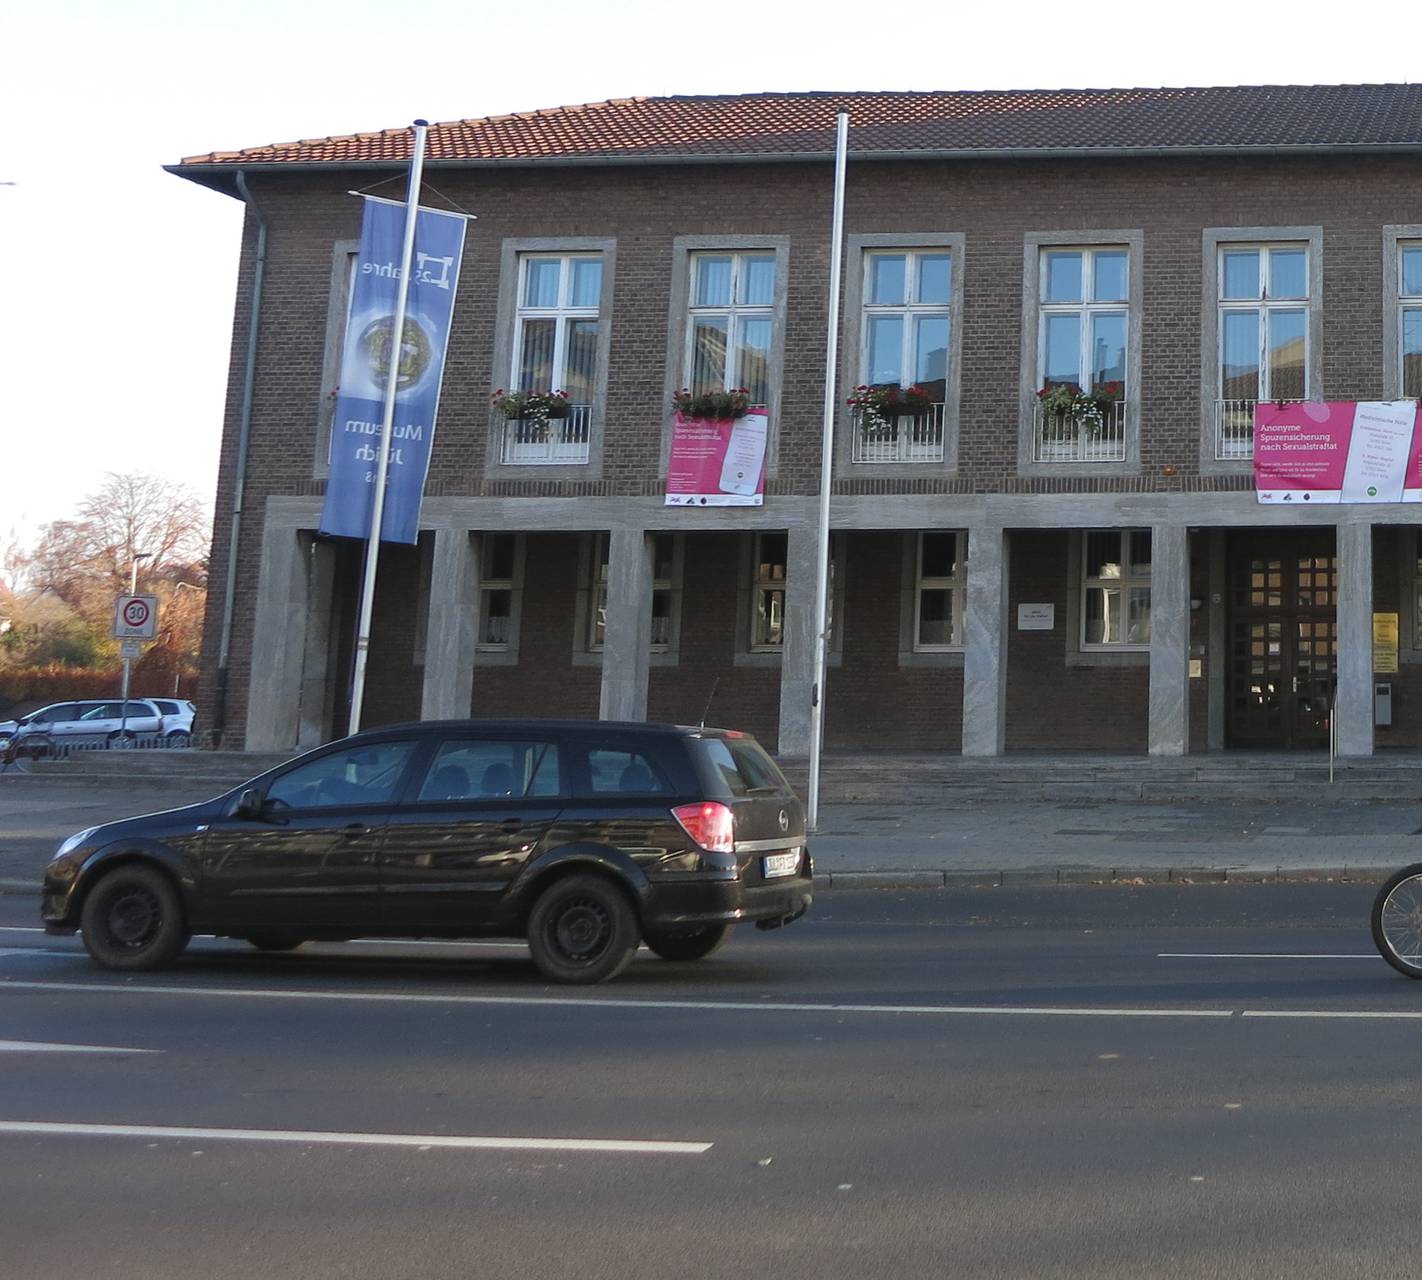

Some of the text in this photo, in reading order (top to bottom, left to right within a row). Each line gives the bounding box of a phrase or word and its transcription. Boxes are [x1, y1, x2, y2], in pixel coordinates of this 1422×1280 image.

[1260, 424, 1301, 433] Anonyme
[1260, 433, 1331, 443] Spurensicherung
[1282, 442, 1337, 451] Sexualstraftat
[129, 606, 145, 619] 30
